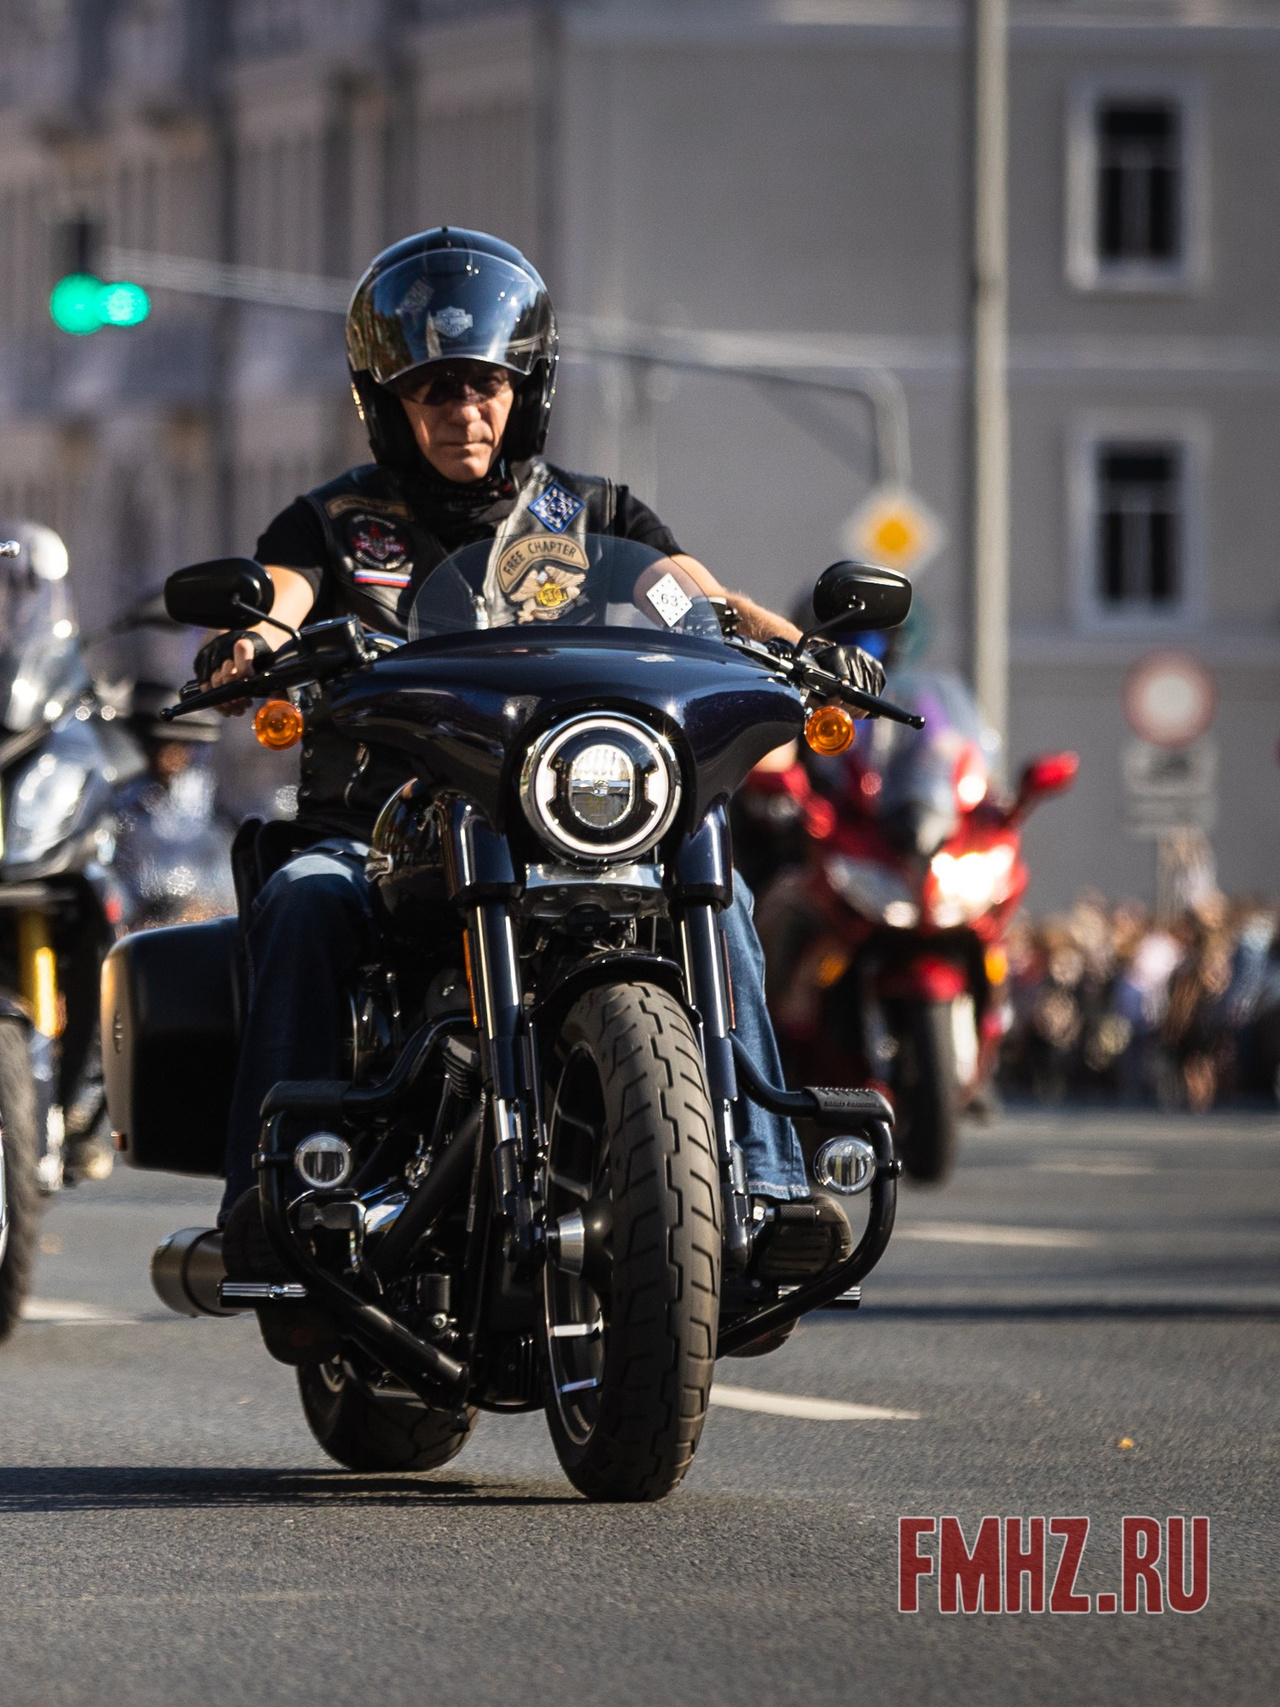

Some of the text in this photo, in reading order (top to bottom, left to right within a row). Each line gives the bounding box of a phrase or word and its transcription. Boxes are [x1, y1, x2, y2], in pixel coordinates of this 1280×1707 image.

[503, 541, 577, 576] FREE CHAPTER
[660, 593, 678, 607] 63
